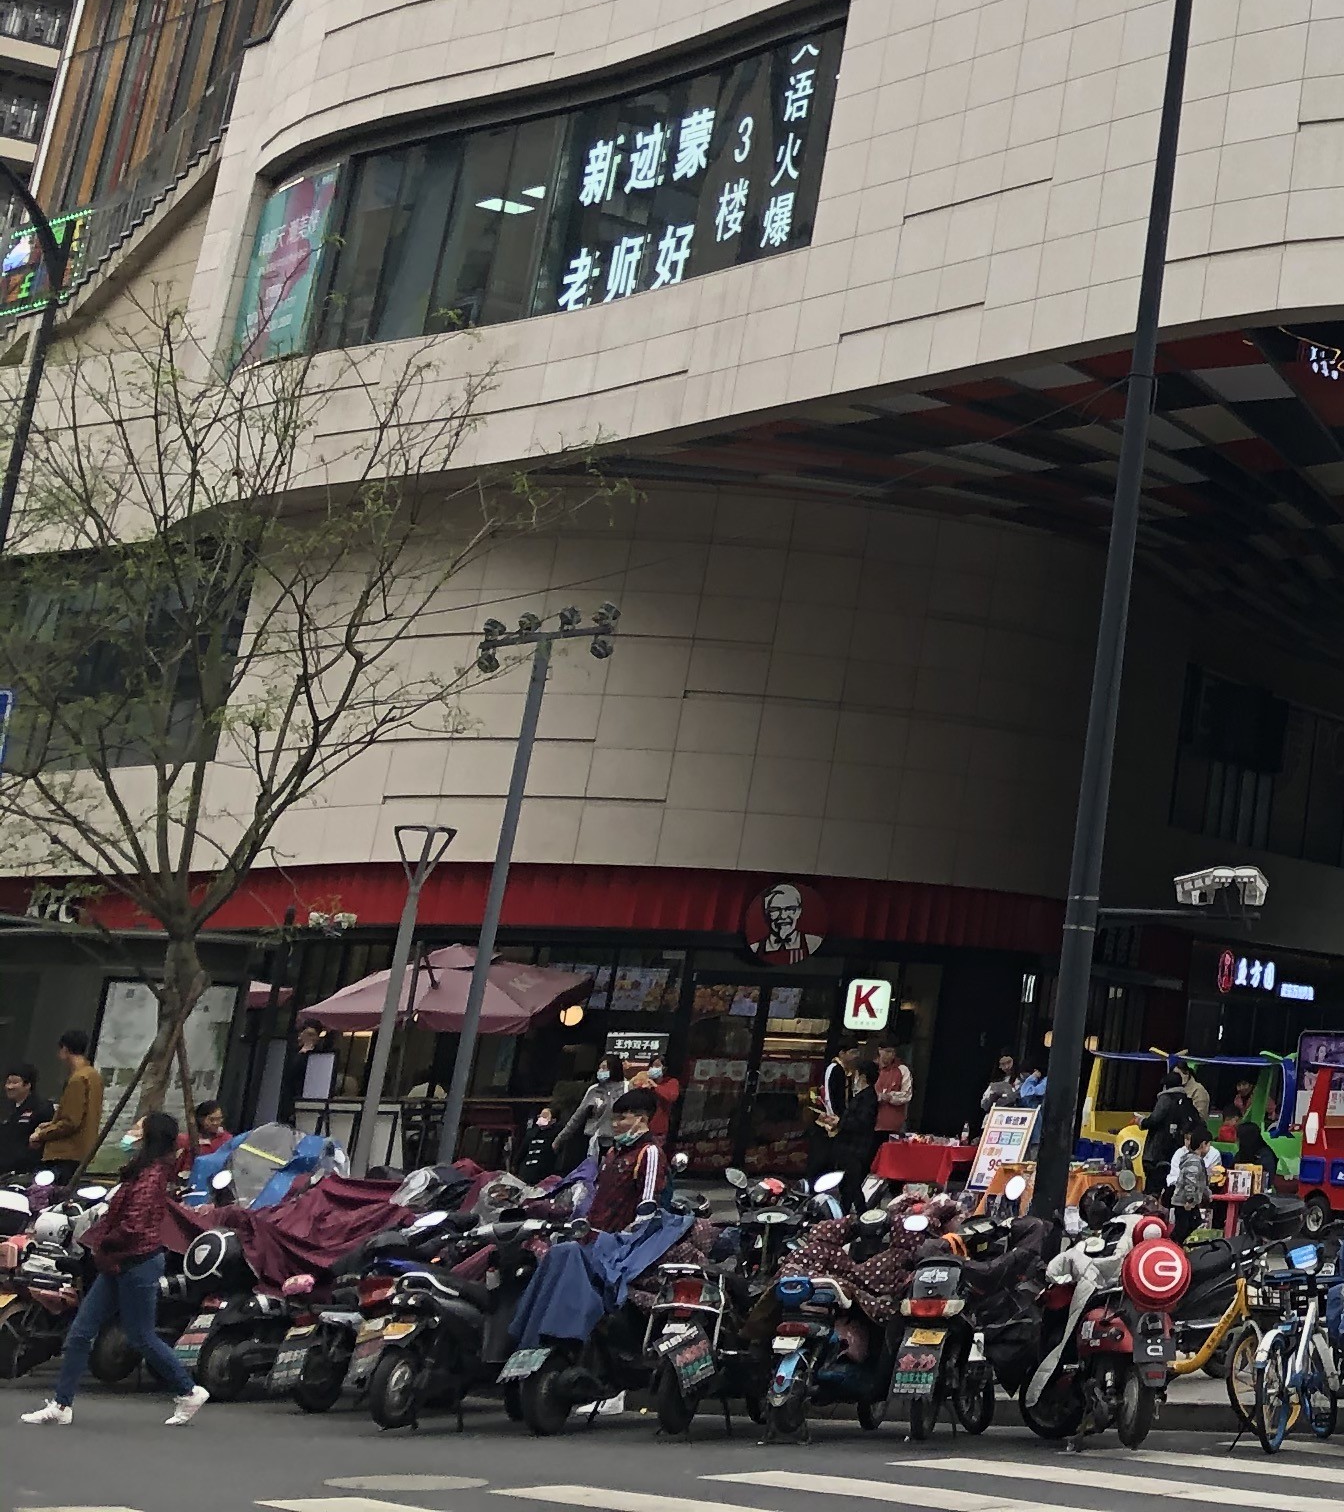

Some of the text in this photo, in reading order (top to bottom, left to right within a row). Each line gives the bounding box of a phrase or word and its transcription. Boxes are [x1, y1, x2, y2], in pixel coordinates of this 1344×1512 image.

[558, 224, 695, 310] 老师好
[852, 985, 881, 1018] K
